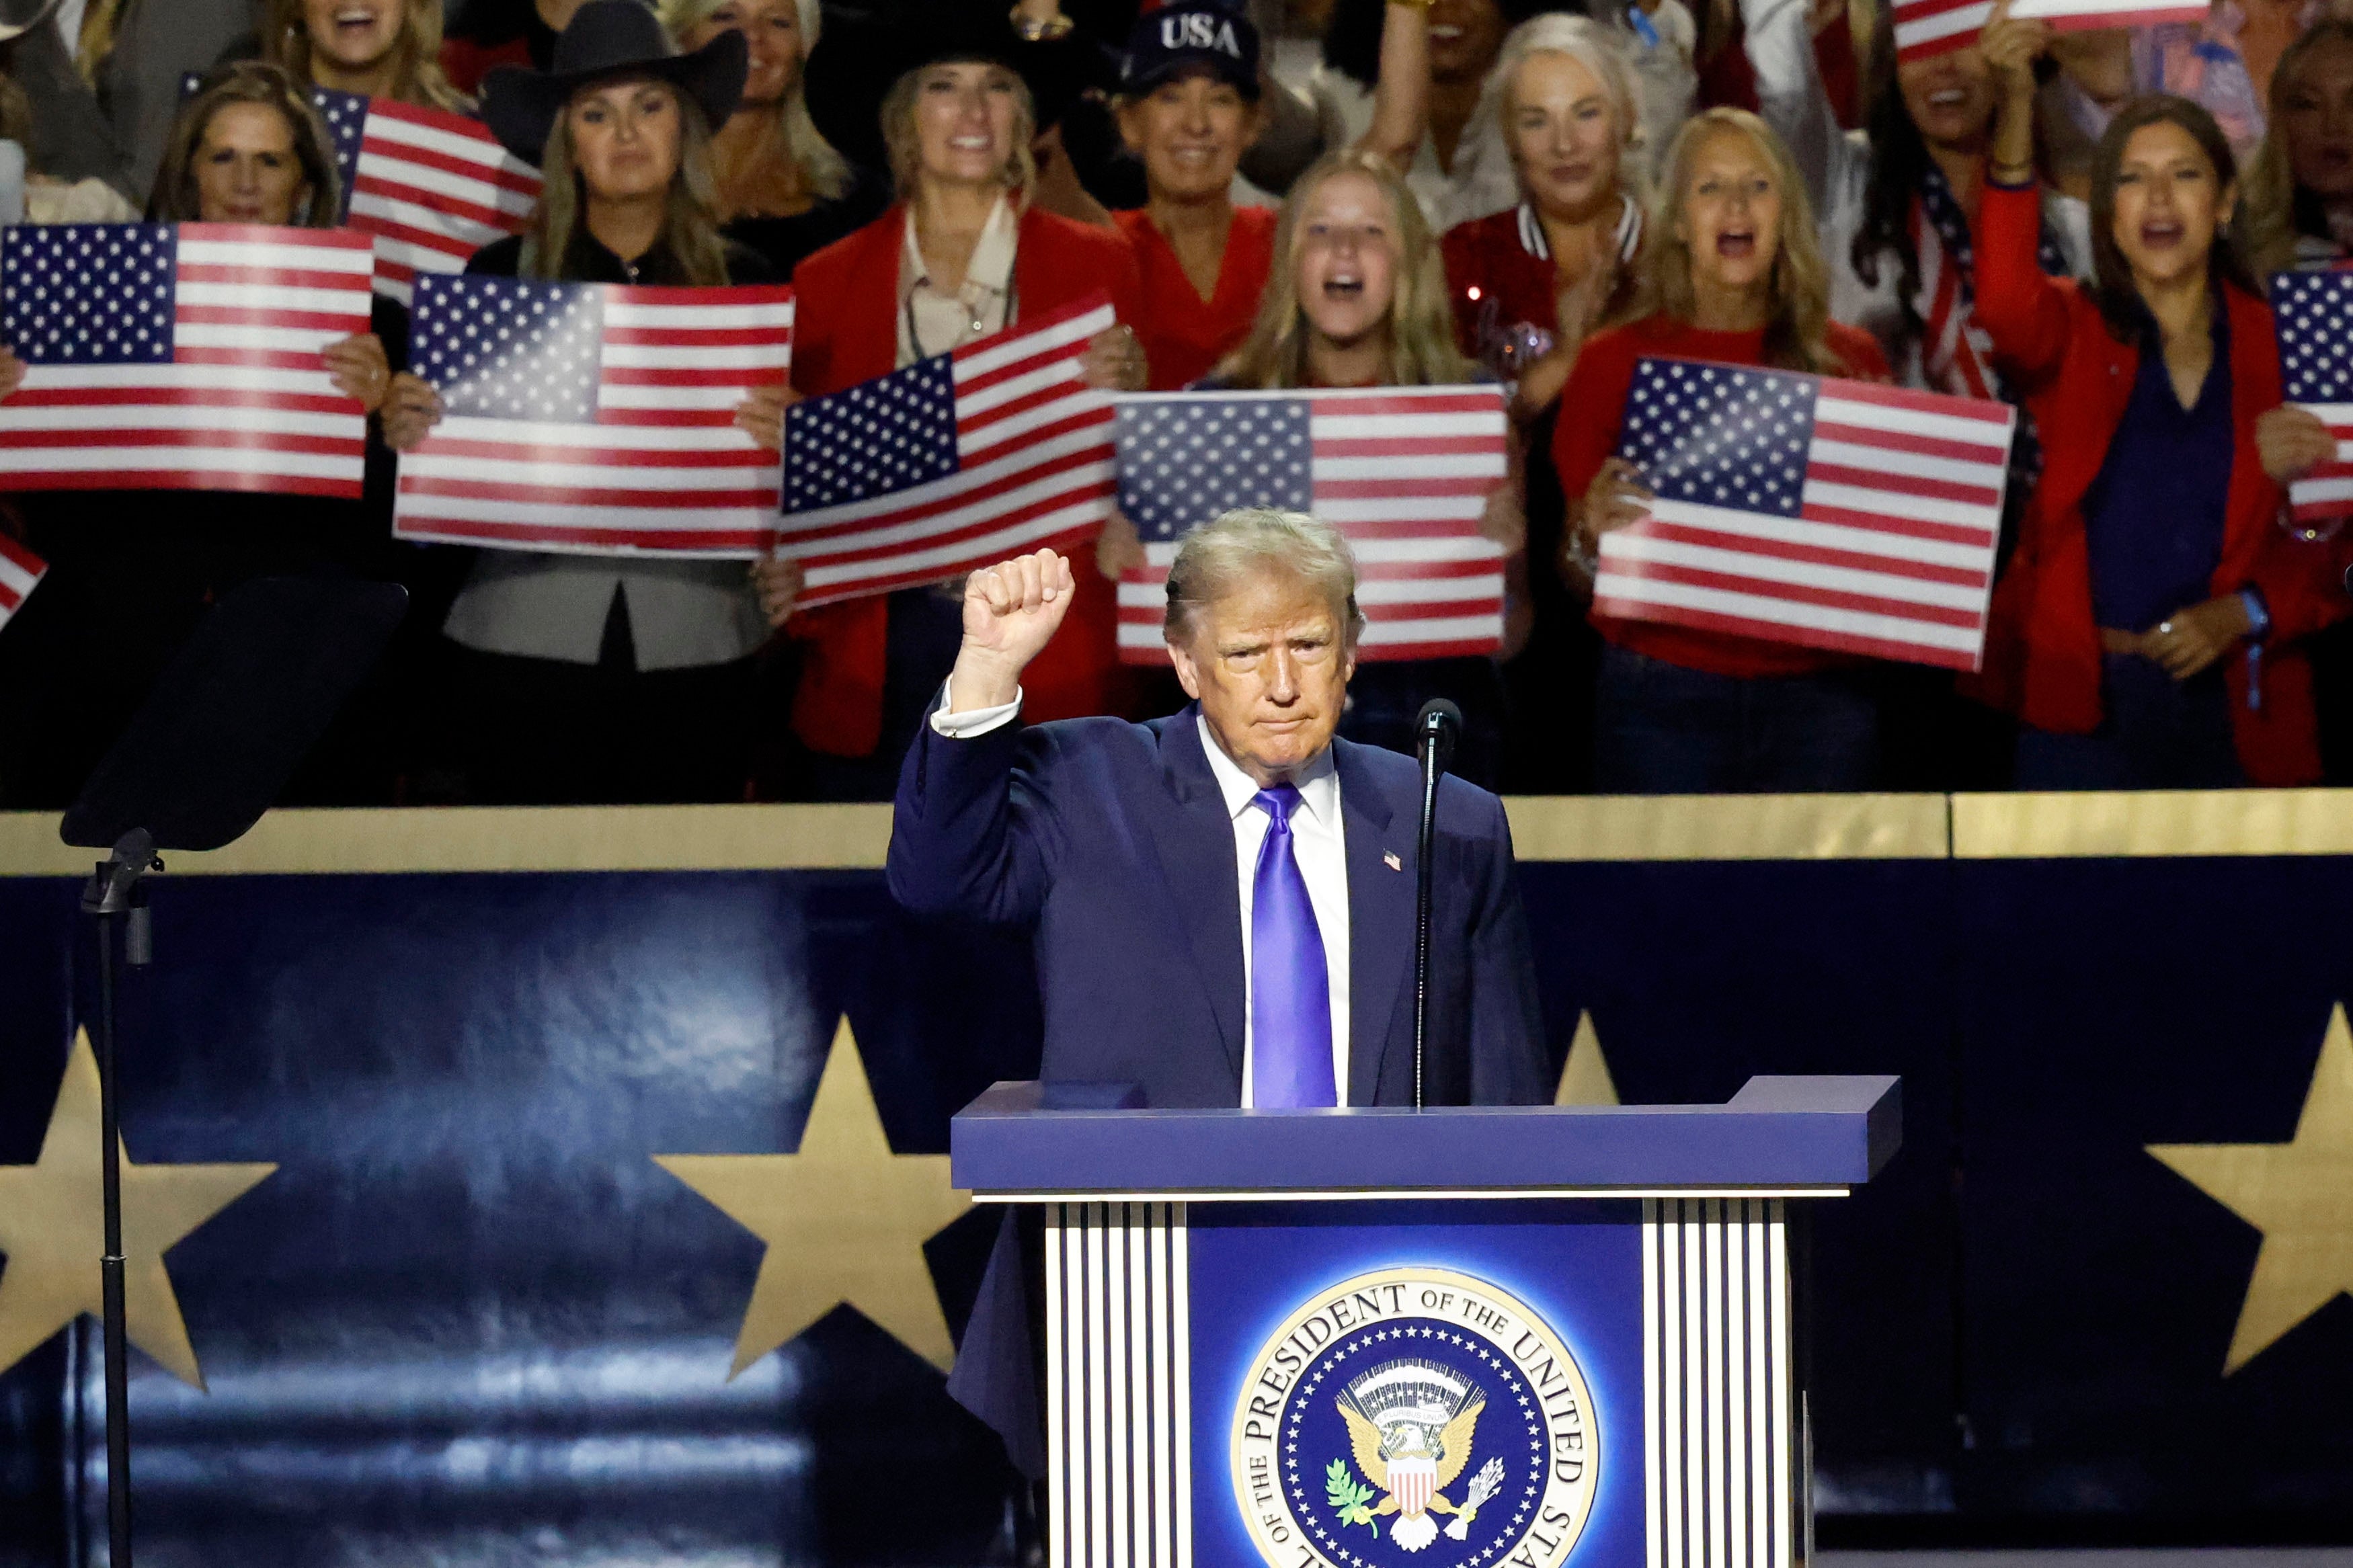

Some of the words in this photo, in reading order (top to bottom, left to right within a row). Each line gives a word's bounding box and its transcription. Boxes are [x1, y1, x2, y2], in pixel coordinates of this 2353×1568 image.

[1161, 12, 1241, 58] USA
[1421, 1290, 1454, 1311] OF
[1462, 1298, 1509, 1336] THE
[1244, 1284, 1406, 1444] PRESIDENT
[1376, 1415, 1384, 1423] E
[1383, 1409, 1422, 1419] PLURIBUS
[1423, 1411, 1447, 1421] UNUM
[1513, 1328, 1583, 1484] UNITED
[1249, 1455, 1274, 1509] THE
[1263, 1514, 1289, 1543] OF
[1501, 1505, 1570, 1568] STA
